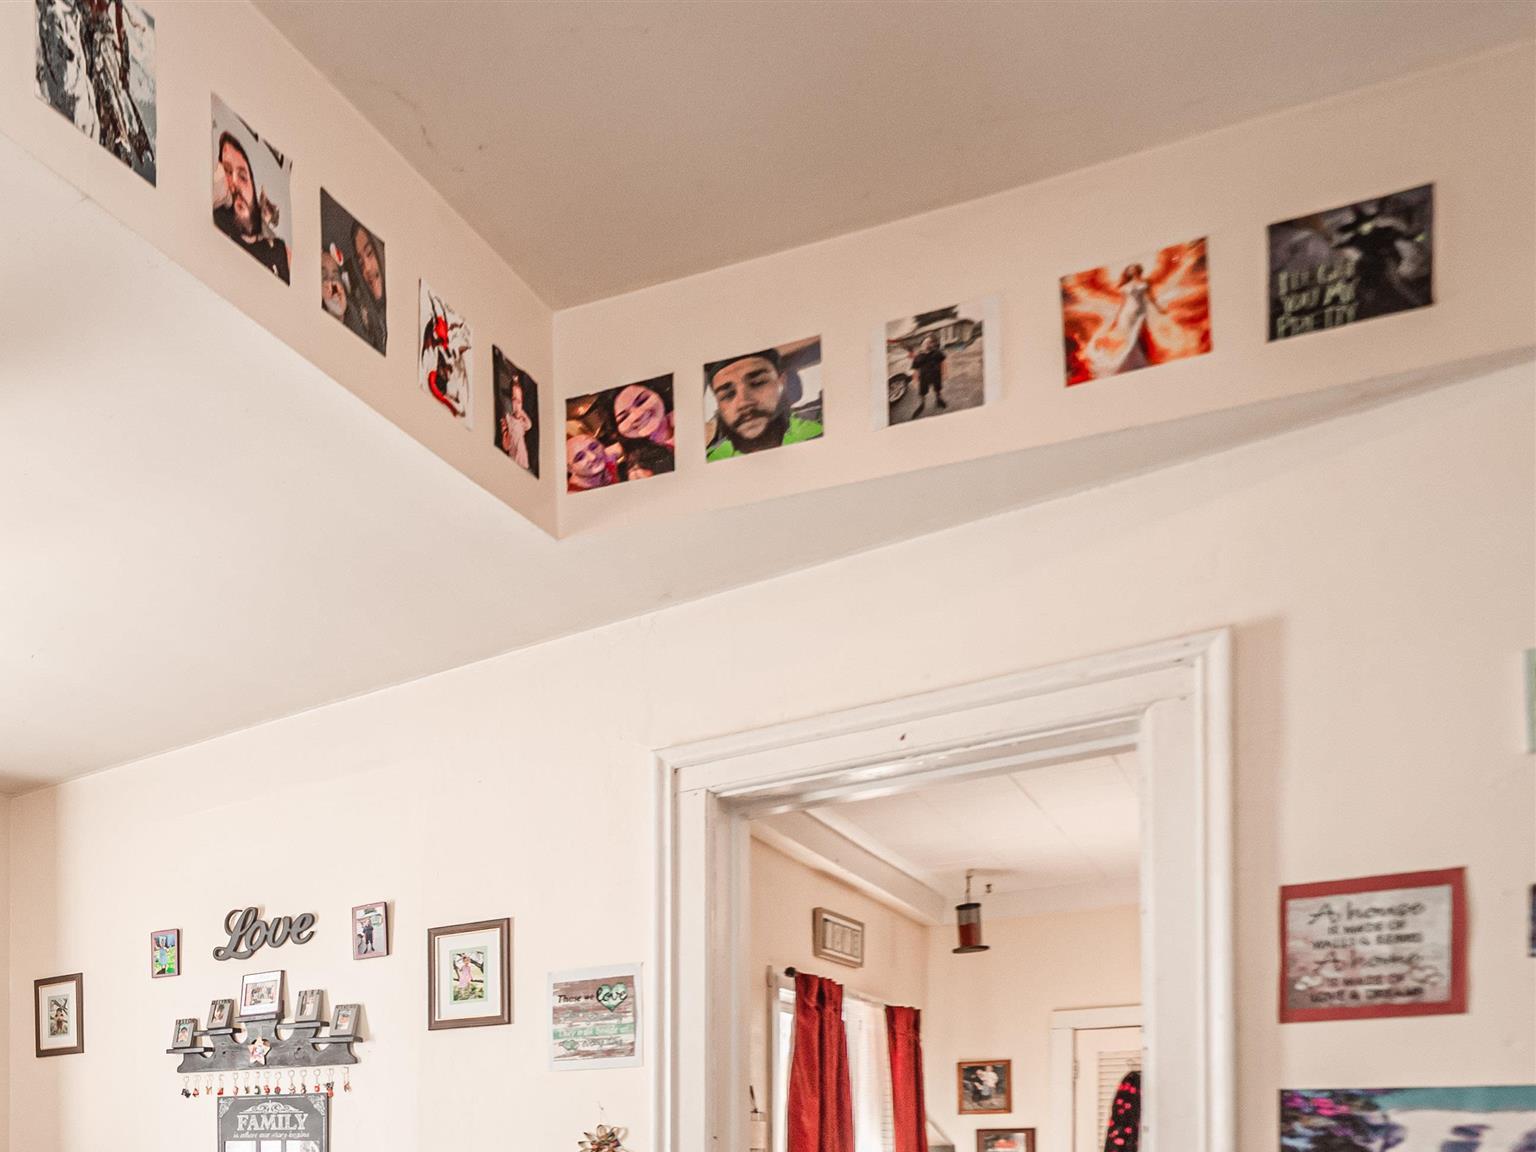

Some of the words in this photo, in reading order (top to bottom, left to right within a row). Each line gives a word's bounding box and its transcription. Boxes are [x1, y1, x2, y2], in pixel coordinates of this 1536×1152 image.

[1347, 901, 1426, 921] house
[213, 906, 316, 961] Love
[237, 1113, 309, 1131] FAMILY
